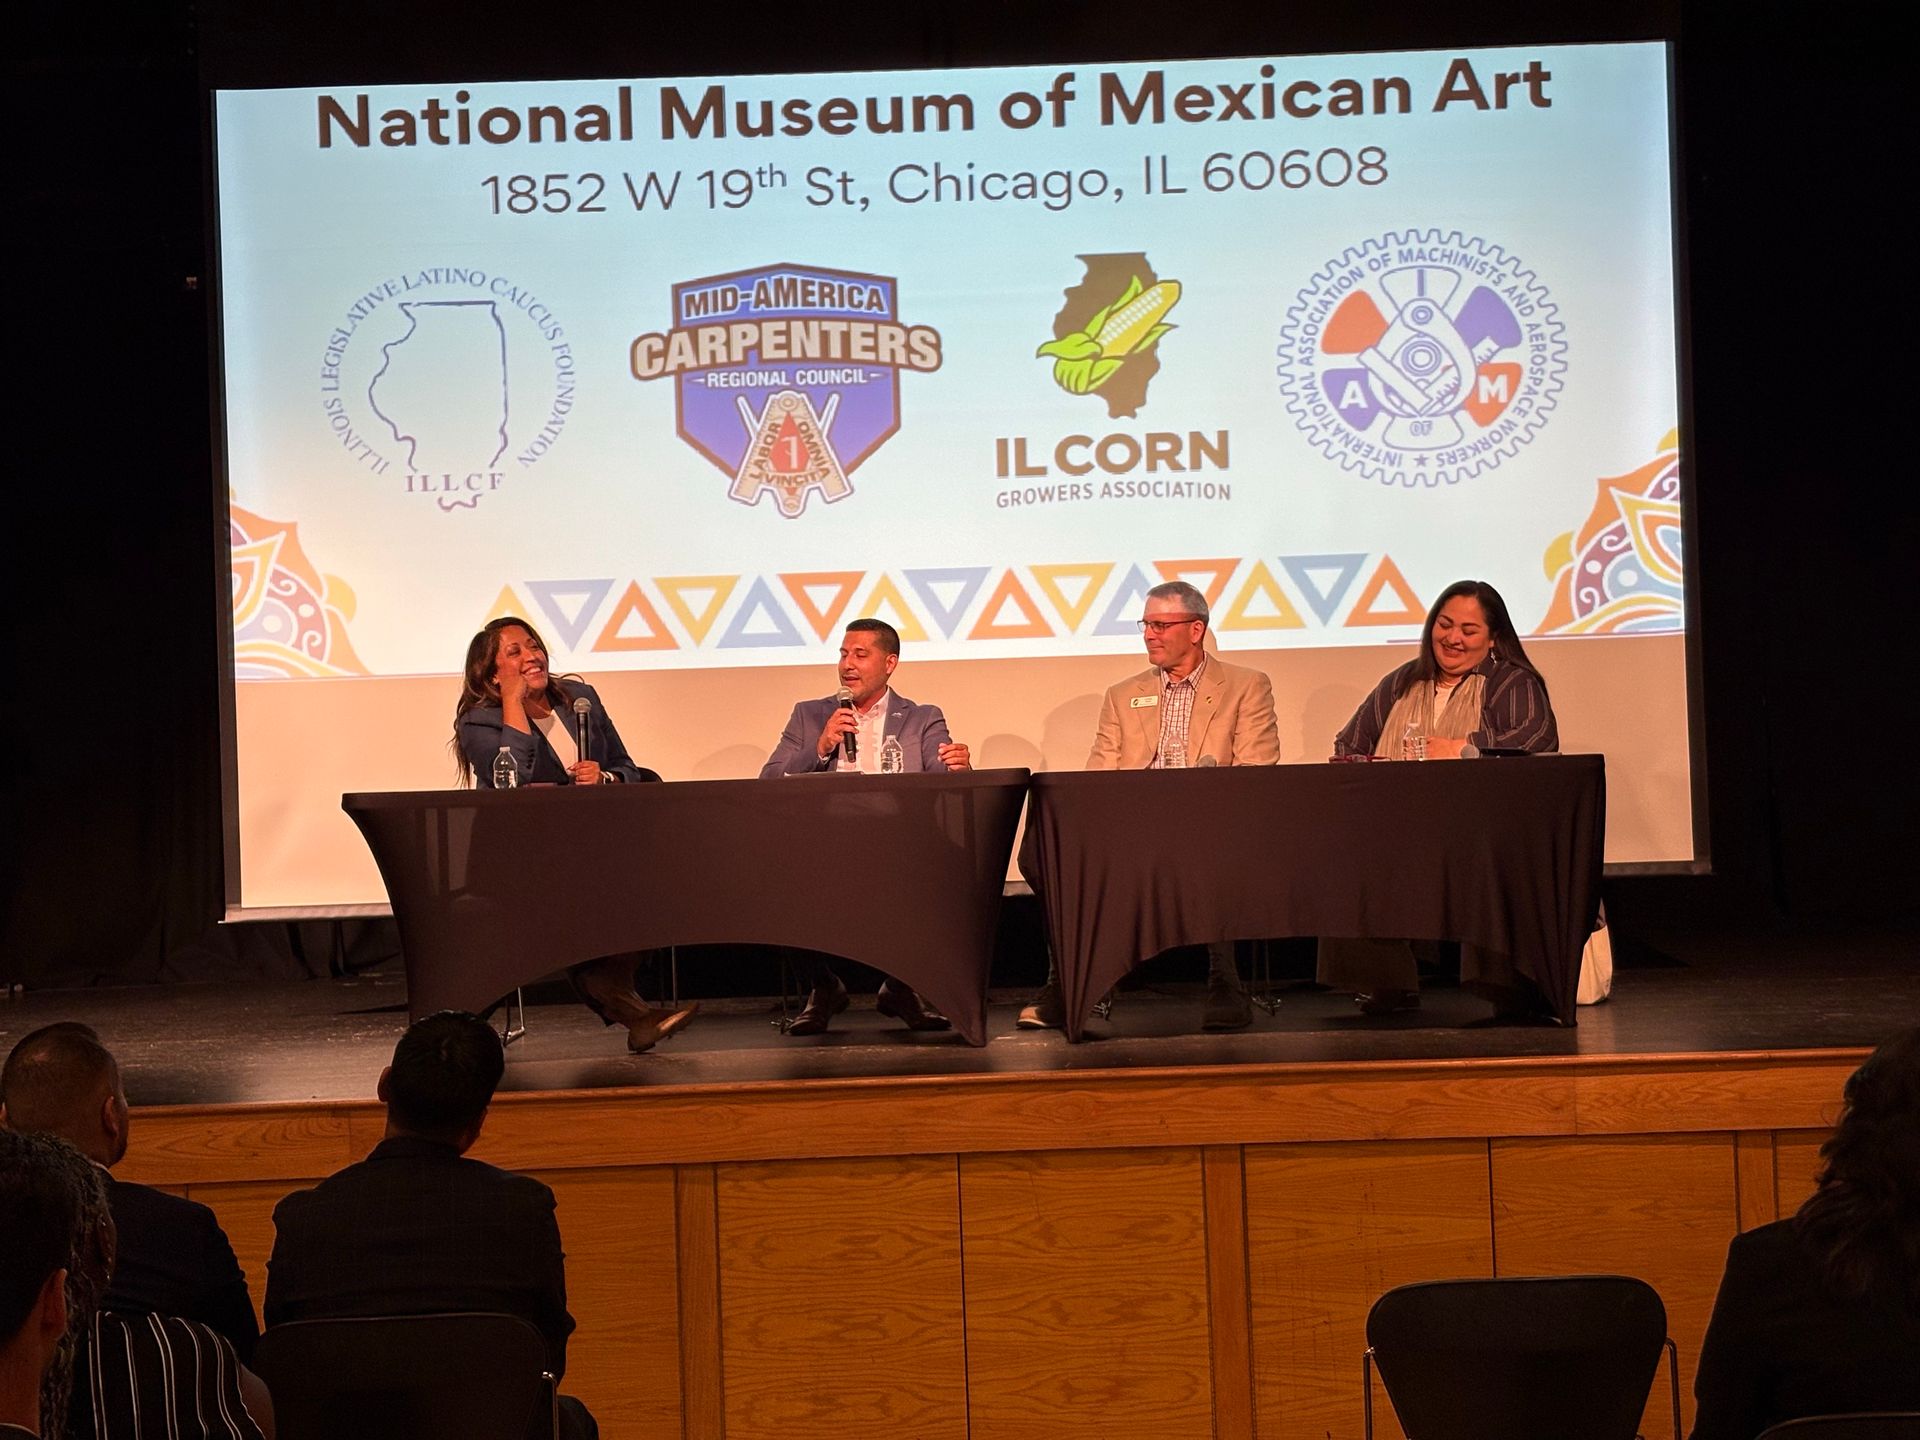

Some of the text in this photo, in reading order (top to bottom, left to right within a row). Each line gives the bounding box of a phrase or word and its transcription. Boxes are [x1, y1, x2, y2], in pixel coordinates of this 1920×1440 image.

[318, 58, 1552, 148] National Museum of Mexican Art
[481, 146, 1389, 214] 1852 W 19th St, Chicago, IL 60608
[683, 276, 885, 318] MID-AMERICA
[321, 268, 576, 475] ILLINOIS LEGISLATIVE LATINO CAUCUS FOUNDATION
[633, 319, 939, 378] CARPENTERS
[1298, 247, 1548, 468] INTERNATIONAL ASSOCIATION OF MACHINISTS AND AEROSPACE WORKERS
[707, 368, 867, 388] REGIONAL COUNCIL
[1338, 380, 1369, 409] A
[1478, 373, 1508, 404] M
[749, 422, 782, 479] LABOR
[798, 420, 831, 478] OMNIA
[406, 473, 506, 492] ILLCF
[765, 472, 819, 486] VINCIT
[996, 481, 1231, 508] GROWERS ASSOCIATION
